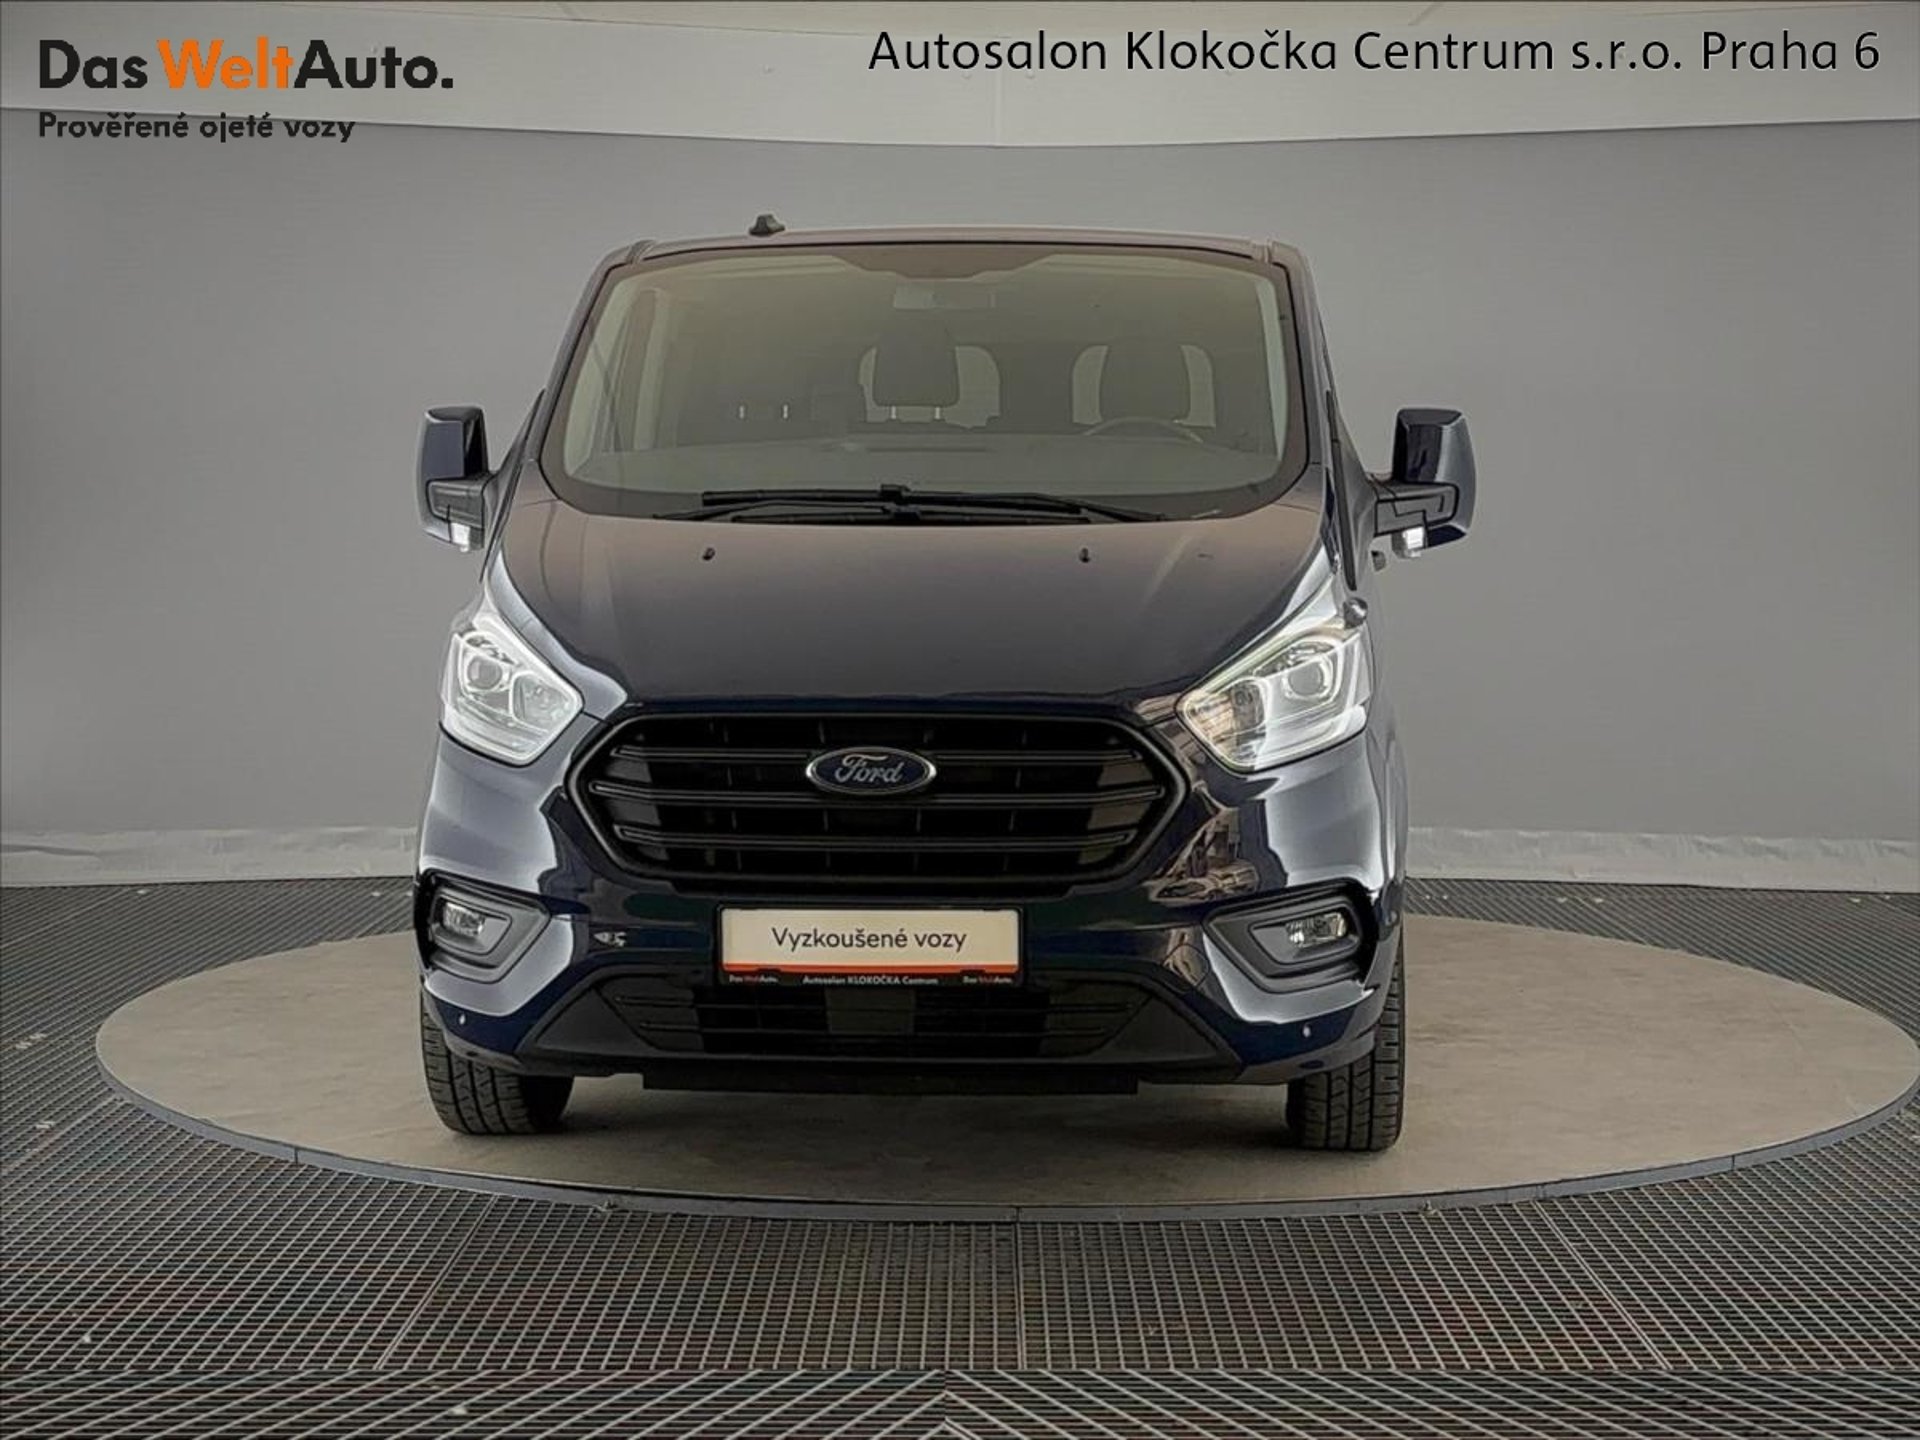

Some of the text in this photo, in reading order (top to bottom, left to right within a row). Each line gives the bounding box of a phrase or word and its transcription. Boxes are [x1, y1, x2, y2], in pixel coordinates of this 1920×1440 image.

[834, 753, 905, 783] Ford
[771, 926, 967, 953] Vyzkoušené vozy
